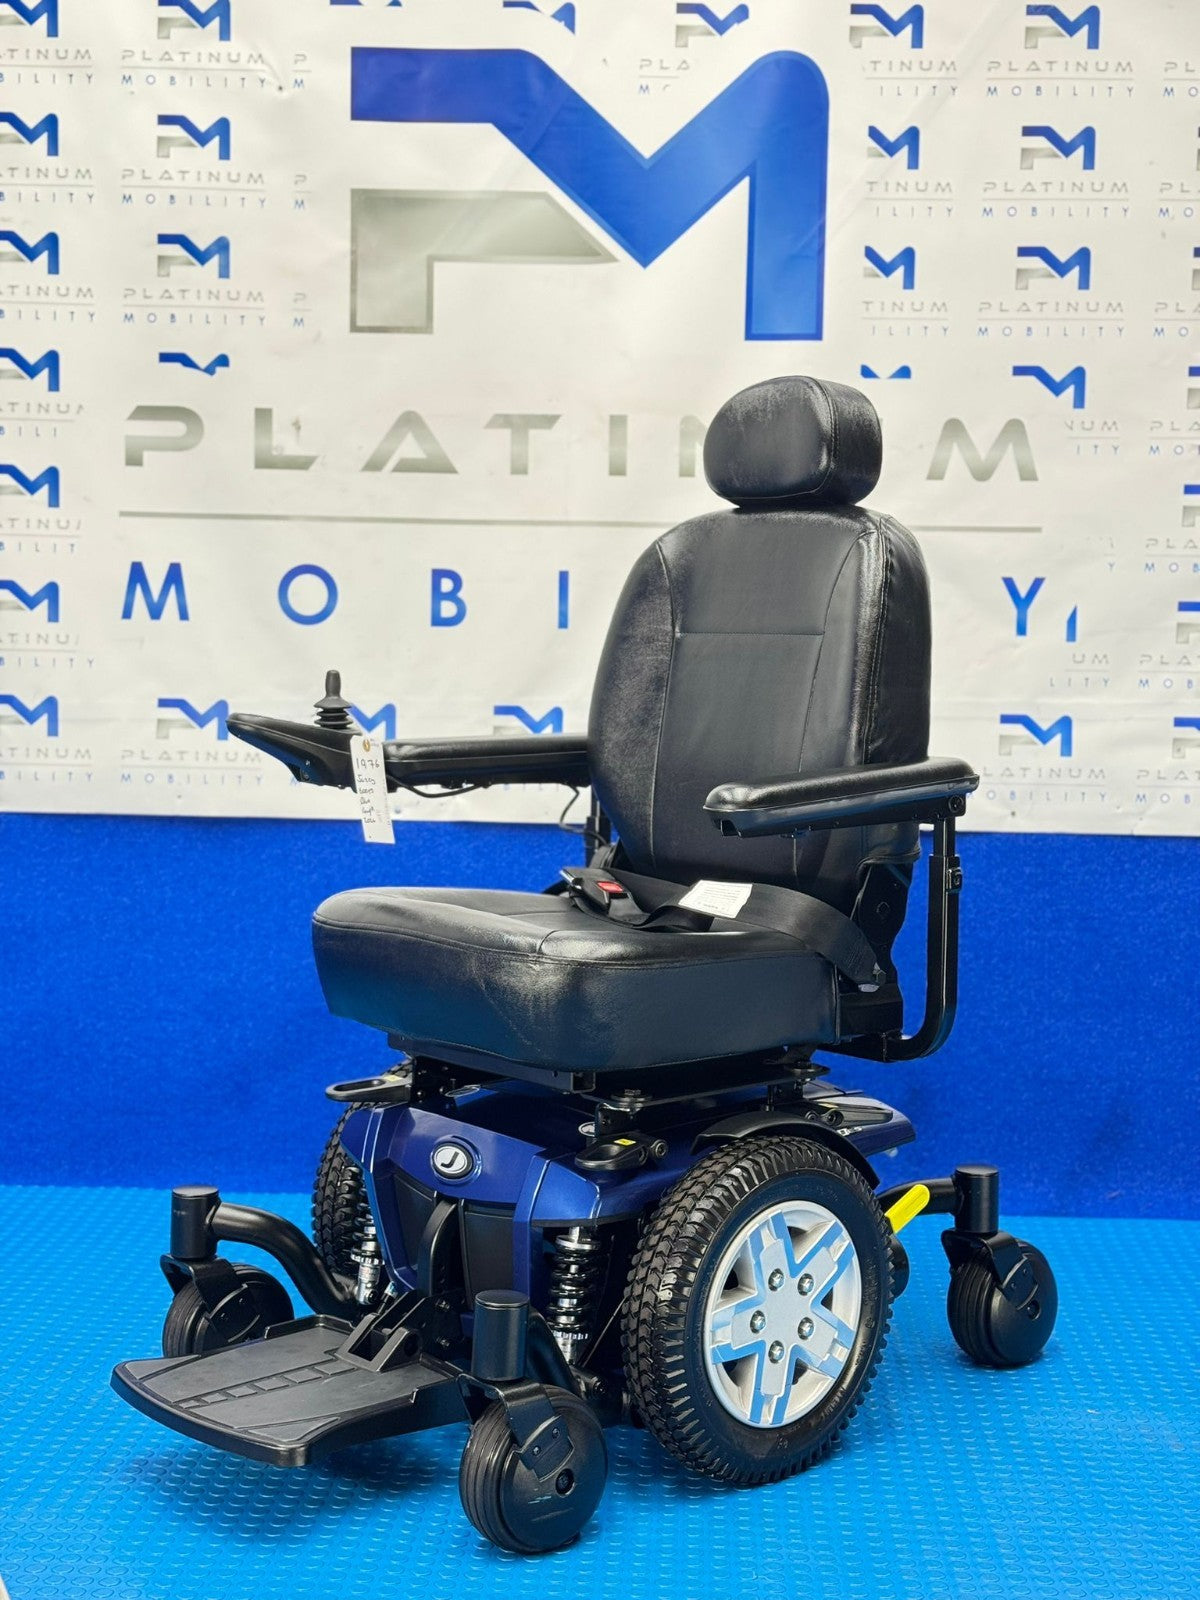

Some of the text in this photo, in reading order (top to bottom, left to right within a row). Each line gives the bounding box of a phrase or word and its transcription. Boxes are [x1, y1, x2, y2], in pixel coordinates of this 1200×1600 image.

[0, 48, 91, 60] TINUM
[122, 50, 264, 64] PLATINUM
[870, 60, 956, 71] TINUM
[987, 61, 1133, 72] PLATINUM
[121, 74, 265, 88] MOBILITY
[987, 86, 1133, 96] MOBILITY
[0, 167, 92, 179] TINUM
[122, 169, 264, 184] PLATINUM
[983, 182, 1128, 192] PLATINUM
[122, 194, 265, 208] MOBILITY
[982, 206, 1128, 217] MOBILITY
[0, 285, 93, 298] TINUM
[124, 288, 263, 302] PLATINUM
[979, 302, 1123, 312] PLATINUM
[123, 313, 265, 325] MOBILITY
[977, 326, 1124, 336] MOBILITY
[125, 405, 1039, 482] PLATIM
[121, 560, 1046, 636] MOBIY
[0, 747, 91, 758] TINUM
[121, 750, 262, 763] PLATINUM
[356, 758, 380, 769] 1976
[121, 773, 261, 784] MOBILITY
[983, 767, 1106, 779] LATINUM
[986, 790, 1106, 801] OBILITY
